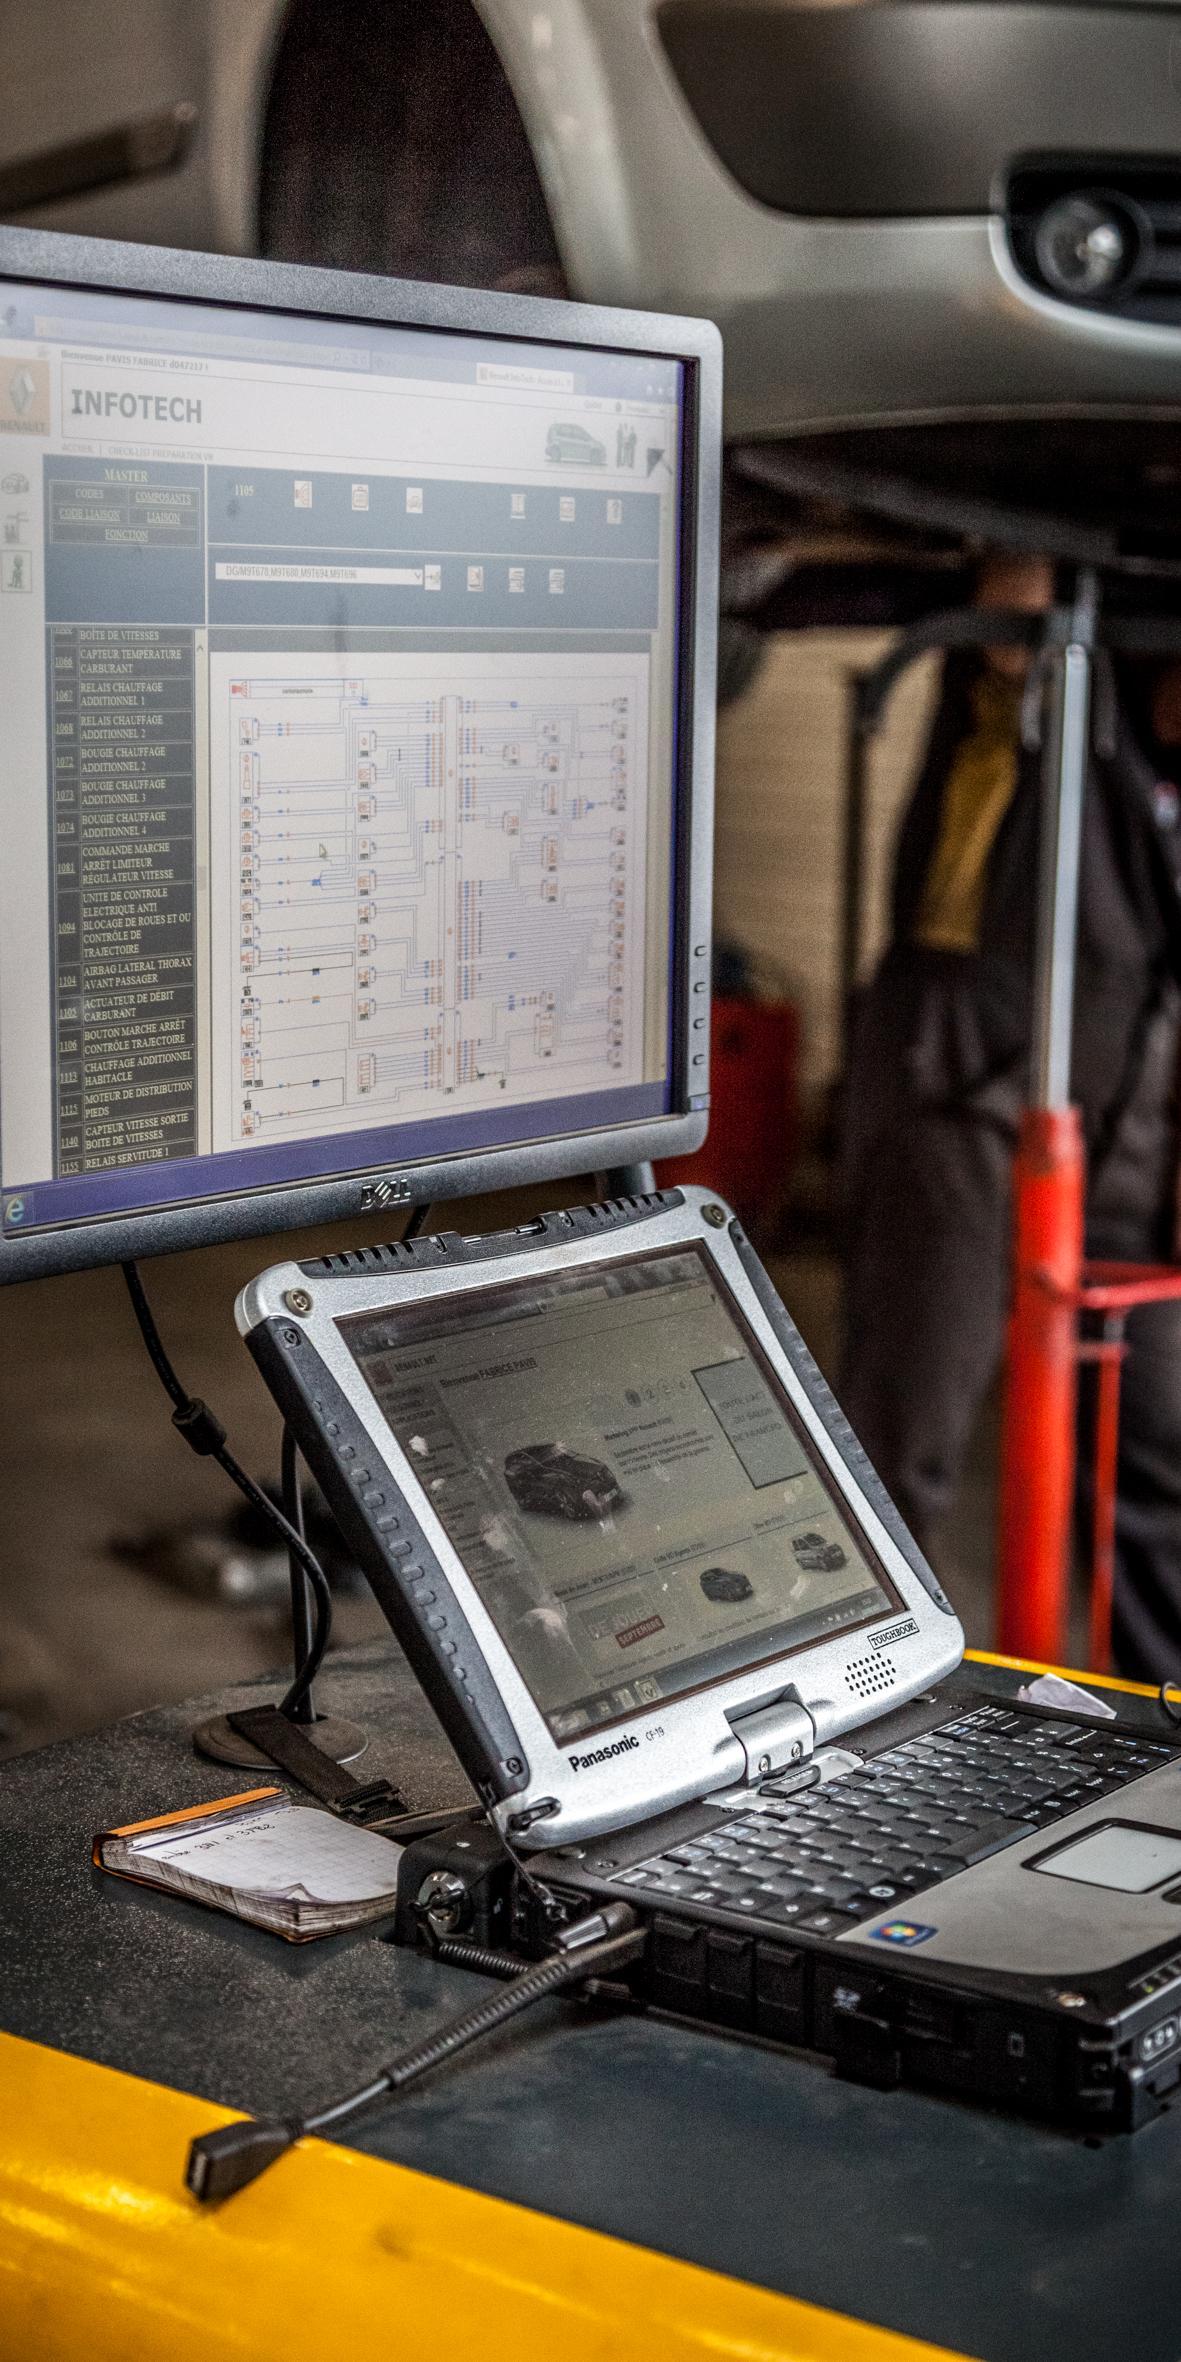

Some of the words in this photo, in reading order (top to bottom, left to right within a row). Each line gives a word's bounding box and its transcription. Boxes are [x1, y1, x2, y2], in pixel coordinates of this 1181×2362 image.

[71, 388, 202, 424] INFOTECH
[0, 419, 45, 434] RENAULT
[104, 468, 148, 482] MASTER
[75, 488, 104, 499] CODES
[235, 484, 254, 496] 1105
[136, 491, 192, 505] COMPOSANTS
[59, 509, 85, 521] CODE
[86, 510, 121, 522] LIAISON
[147, 512, 181, 524] LIAISON
[105, 528, 149, 542] FONCTION
[108, 630, 118, 640] DE
[121, 630, 160, 640] VITESSES
[80, 649, 119, 660] CAPTEUR
[55, 656, 73, 668] 1066
[80, 664, 134, 674] CARBURANT
[80, 682, 111, 692] RELAIS
[112, 682, 163, 692] CHAUFFAGE
[80, 696, 138, 706] ADDITIONNEL
[80, 715, 112, 726] RELAIS
[113, 715, 164, 725] CHAUFFAGE
[81, 729, 138, 740] ADDITIONNEL
[81, 748, 114, 758] BOUGIE
[116, 747, 166, 756] CHAUFFAGE
[82, 762, 139, 773] ADDITIONNEL
[82, 780, 114, 792] BOUGIE
[116, 779, 166, 790] CHAUFFAGE
[82, 794, 139, 805] ADDITIONNEL
[82, 813, 114, 824] BOUGIE
[116, 812, 167, 823] CHAUFFAGE
[82, 826, 139, 838] ADDITIONNEL
[82, 844, 133, 856] COMMANDE
[134, 842, 170, 854] MARCHE
[112, 858, 152, 869] LIMITEUR
[141, 869, 174, 880] VITESSE
[110, 891, 122, 901] DE
[138, 903, 157, 912] ANTI
[58, 922, 76, 934] 1094
[84, 918, 124, 931] BLOCAGE
[126, 918, 137, 928] DE
[138, 916, 166, 926] ROUES
[167, 914, 177, 924] ET
[178, 913, 191, 922] OU
[130, 930, 142, 940] DE
[84, 944, 140, 958] TRAJECTOIRE
[84, 964, 117, 977] AIRBAG
[158, 958, 192, 969] THORAX
[59, 976, 76, 988] 1104
[84, 978, 114, 990] AVANT
[116, 974, 158, 986] PASSAGER
[84, 996, 136, 1009] ACTUATEUR
[137, 994, 148, 1004] DE
[60, 1008, 77, 1019] 1105
[84, 1008, 136, 1022] CARBURANT
[84, 1028, 120, 1042] BOUTON
[121, 1024, 157, 1036] MARCHE
[60, 1040, 78, 1052] 1106
[84, 1040, 130, 1054] CONTRÔLE
[132, 1034, 185, 1048] TRAJECTOIRE
[85, 1059, 135, 1072] CHAUFFAGE
[137, 1051, 192, 1066] ADDITIONNEL
[85, 1071, 133, 1086] HABITACLE
[85, 1092, 121, 1105] MOTEUR
[123, 1088, 134, 1099] DE
[136, 1080, 193, 1096] DISTRIBUTION
[86, 1106, 110, 1118] PIEDS
[86, 1122, 124, 1136] CAPTEUR
[126, 1117, 158, 1130] VITESSE
[160, 1112, 190, 1124] SORTIE
[113, 1135, 124, 1146] DE
[126, 1130, 164, 1143] VITESSES
[86, 1156, 116, 1169] RELAIS
[118, 1149, 163, 1164] SERVITUDE
[361, 1178, 412, 1210] DELL
[615, 1617, 664, 1645] SEPTEMBRE
[871, 1622, 917, 1648] TOUGHBOOK
[568, 1735, 640, 1772] Panasonic
[646, 1726, 665, 1742] CF-19
